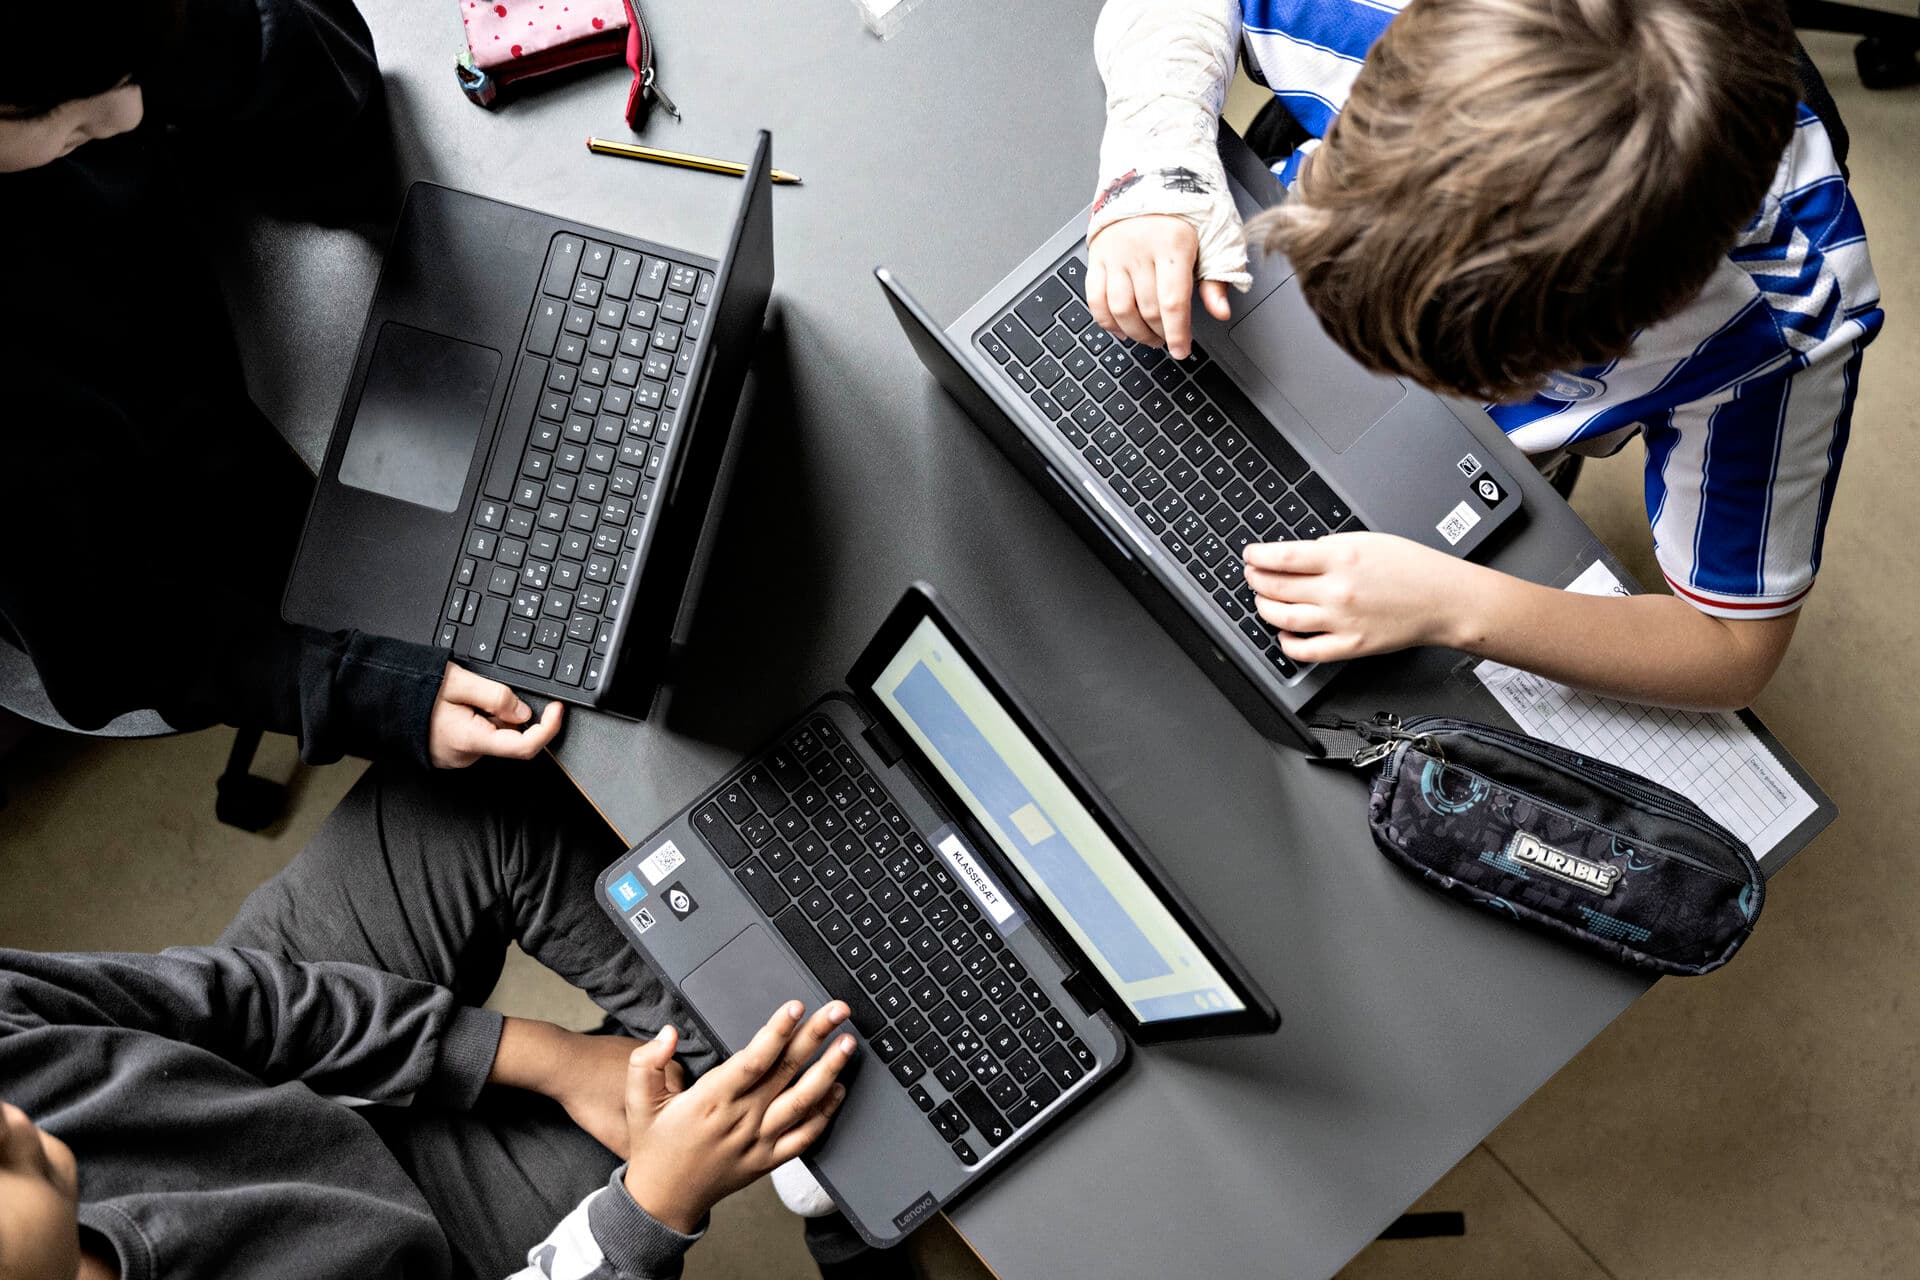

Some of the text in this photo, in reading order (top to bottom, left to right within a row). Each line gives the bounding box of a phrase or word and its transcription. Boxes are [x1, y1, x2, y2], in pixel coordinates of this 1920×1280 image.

[630, 338, 638, 347] w
[591, 367, 600, 375] d
[1097, 381, 1106, 389] p
[1185, 392, 1195, 402] m
[1118, 403, 1125, 411] o
[1154, 401, 1162, 409] k
[1207, 415, 1214, 423] n
[1227, 438, 1234, 446] b
[1158, 448, 1166, 456] u
[1195, 445, 1203, 454] h
[1178, 470, 1187, 478] y
[1216, 467, 1224, 475] g
[524, 489, 533, 498] m
[1199, 493, 1206, 501] t
[1288, 504, 1296, 512] x
[1255, 512, 1264, 520] d
[1309, 526, 1316, 534] z
[562, 570, 570, 578] p
[1517, 837, 1611, 889] DURABLE
[953, 850, 999, 905] KLASSESÆT
[787, 820, 795, 828] a
[826, 869, 835, 877] d
[863, 917, 872, 926] g
[883, 941, 891, 950] h
[923, 990, 931, 999] k
[806, 795, 814, 804] q
[825, 818, 834, 827] w
[900, 916, 909, 924] y
[922, 940, 929, 948] u
[978, 1014, 988, 1022] p
[793, 875, 800, 883] x
[812, 900, 820, 908] c
[851, 947, 858, 956] b
[870, 973, 878, 981] n
[888, 996, 898, 1007] m
[897, 1198, 932, 1227] Lenovo
